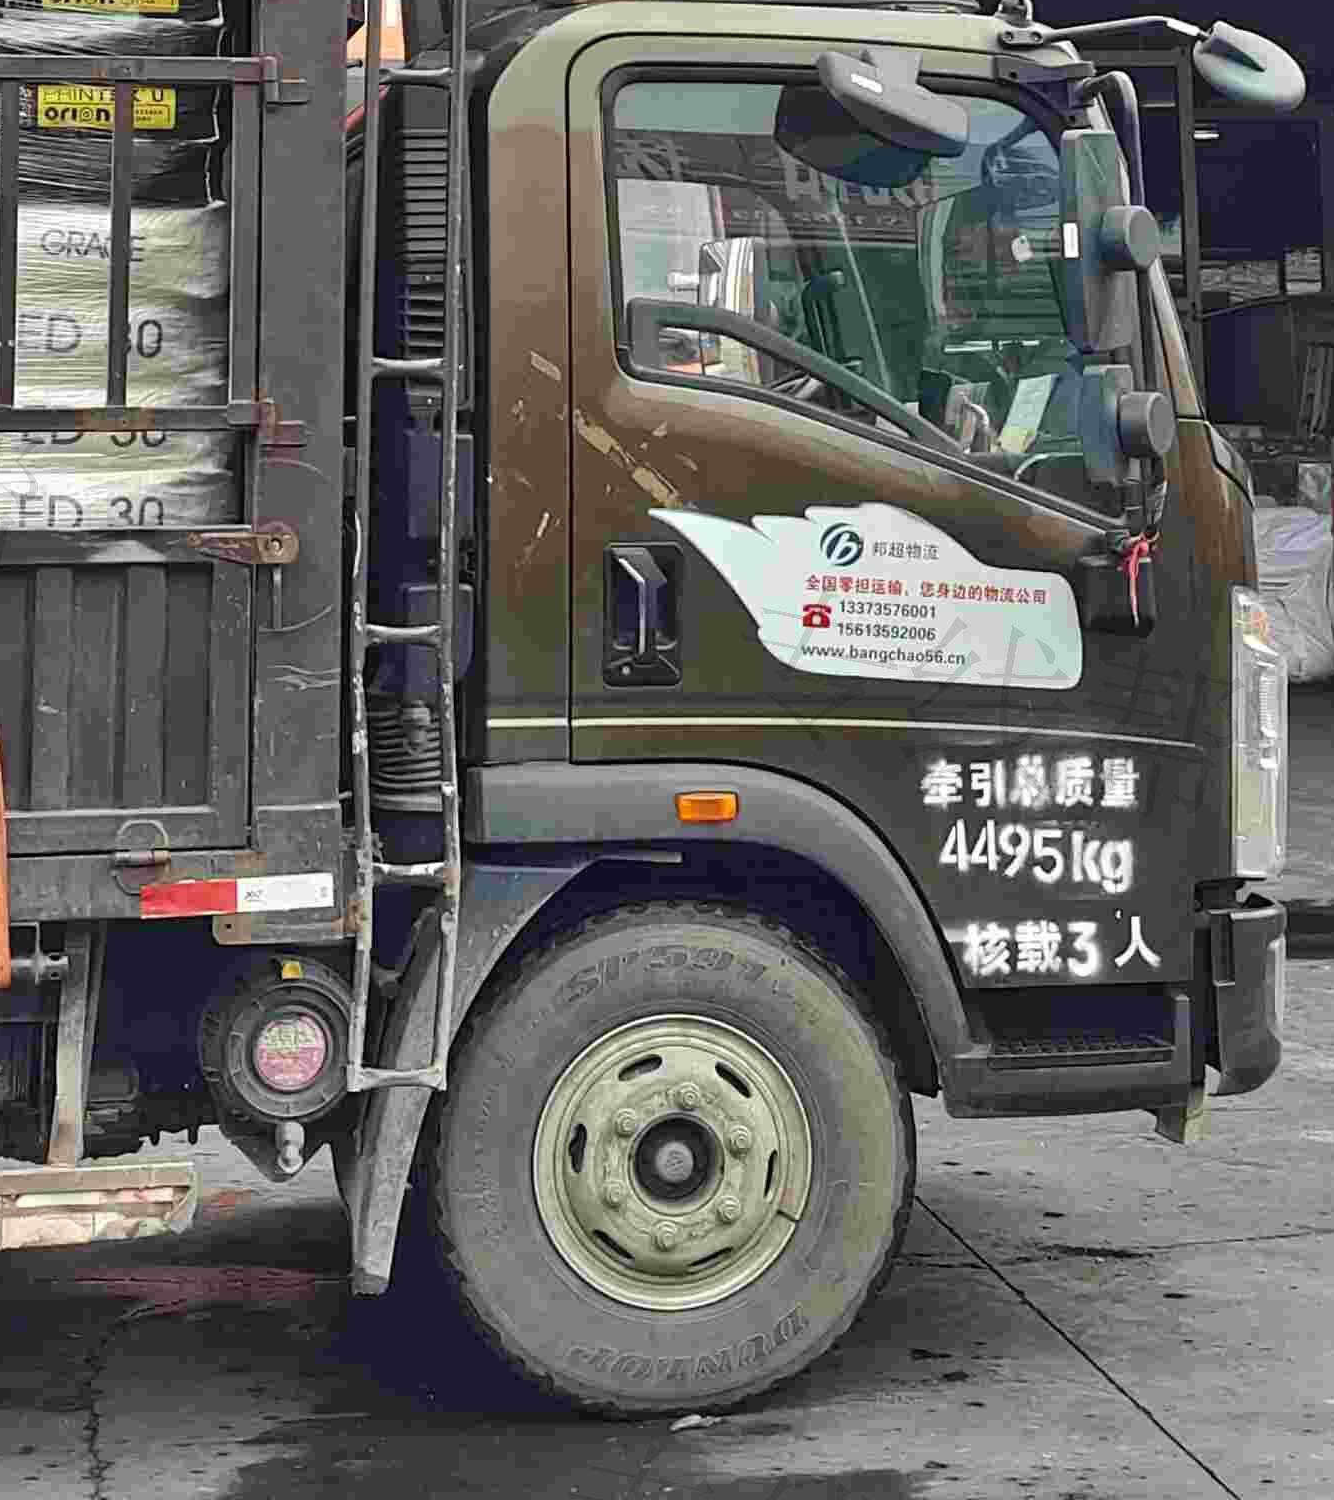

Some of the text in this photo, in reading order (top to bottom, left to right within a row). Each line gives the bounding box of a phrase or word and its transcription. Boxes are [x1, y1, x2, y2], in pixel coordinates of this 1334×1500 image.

[40, 229, 146, 263] GRAE
[839, 600, 937, 620] 13373576001
[836, 622, 937, 642] 15613592006
[800, 643, 966, 667] www.bangchao56.cn
[938, 818, 1134, 895] 4495kg
[964, 915, 1162, 978] 核载3人
